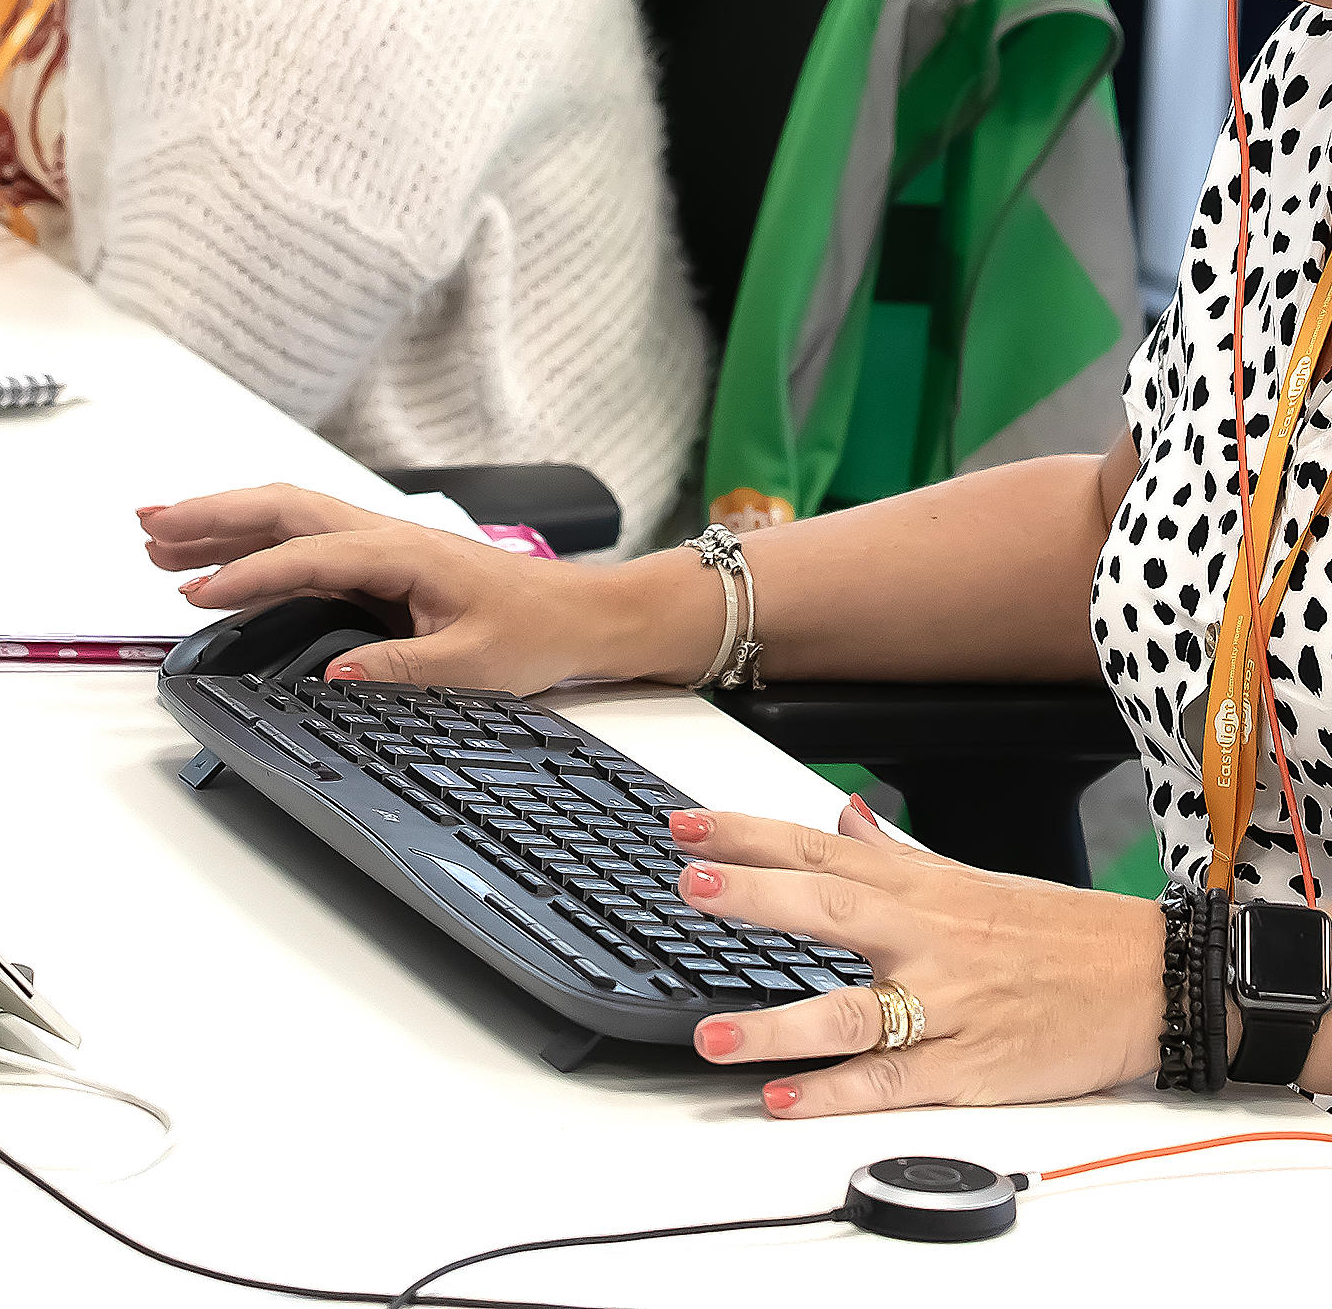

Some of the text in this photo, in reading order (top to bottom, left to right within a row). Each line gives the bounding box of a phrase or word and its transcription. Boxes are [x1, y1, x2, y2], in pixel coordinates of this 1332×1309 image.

[1277, 358, 1312, 438] Eastlight
[1305, 309, 1328, 355] Community
[1217, 615, 1245, 788] Eastlight Community Homes
